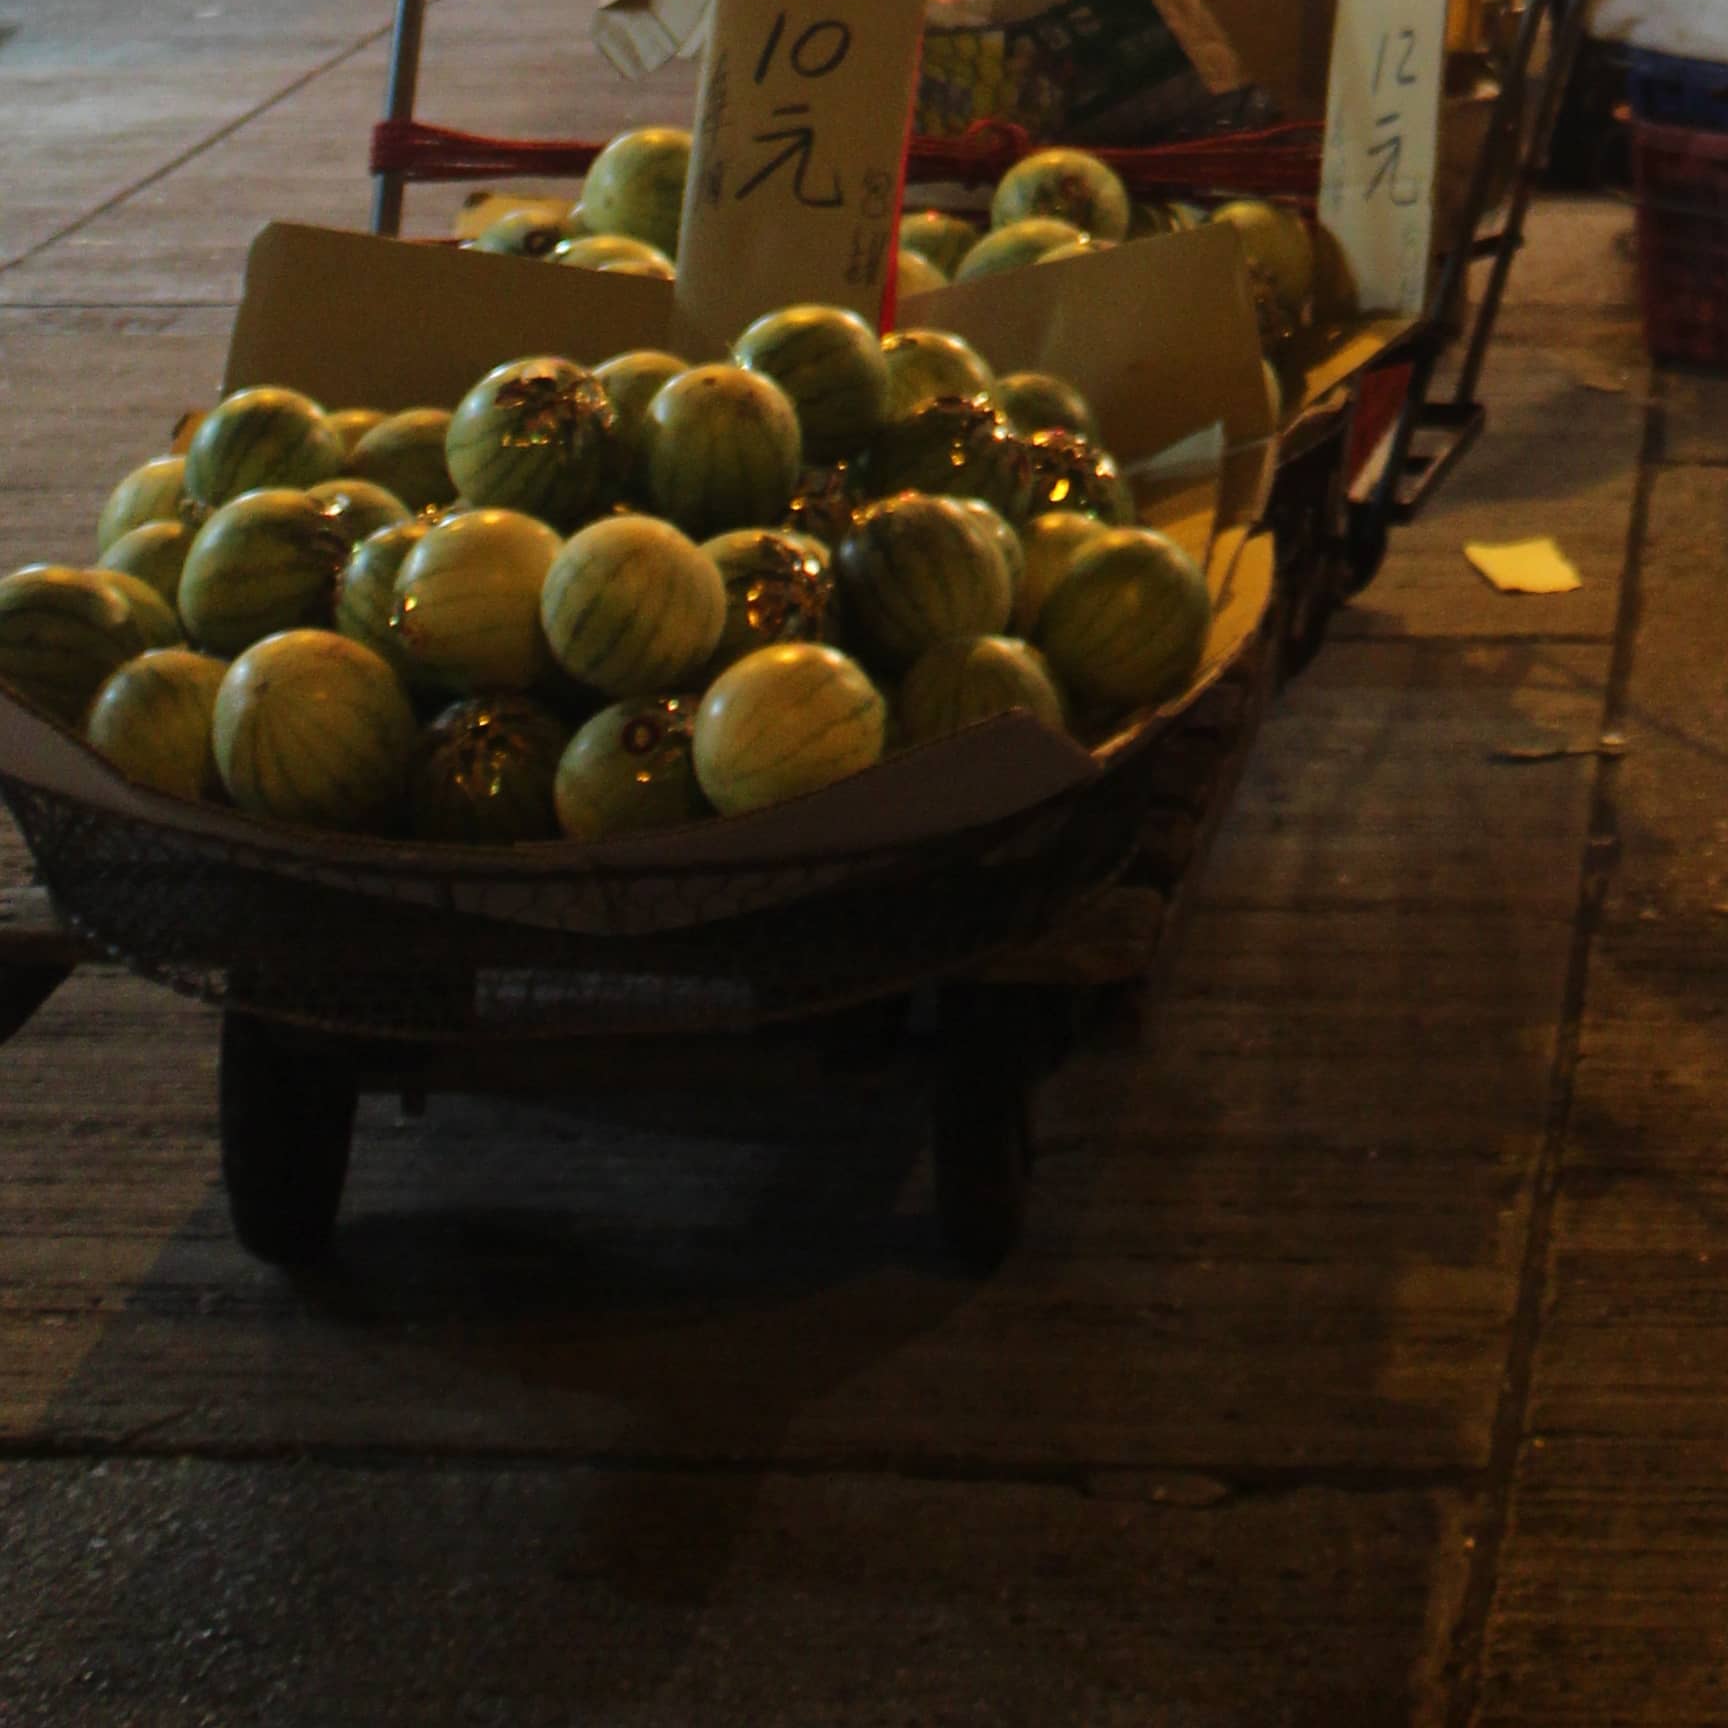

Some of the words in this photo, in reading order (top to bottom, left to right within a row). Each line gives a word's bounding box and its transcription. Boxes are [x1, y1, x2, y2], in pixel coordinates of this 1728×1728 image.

[753, 10, 852, 85] 10
[1372, 28, 1417, 96] 12
[734, 103, 844, 208] 元
[1363, 112, 1418, 207] 元
